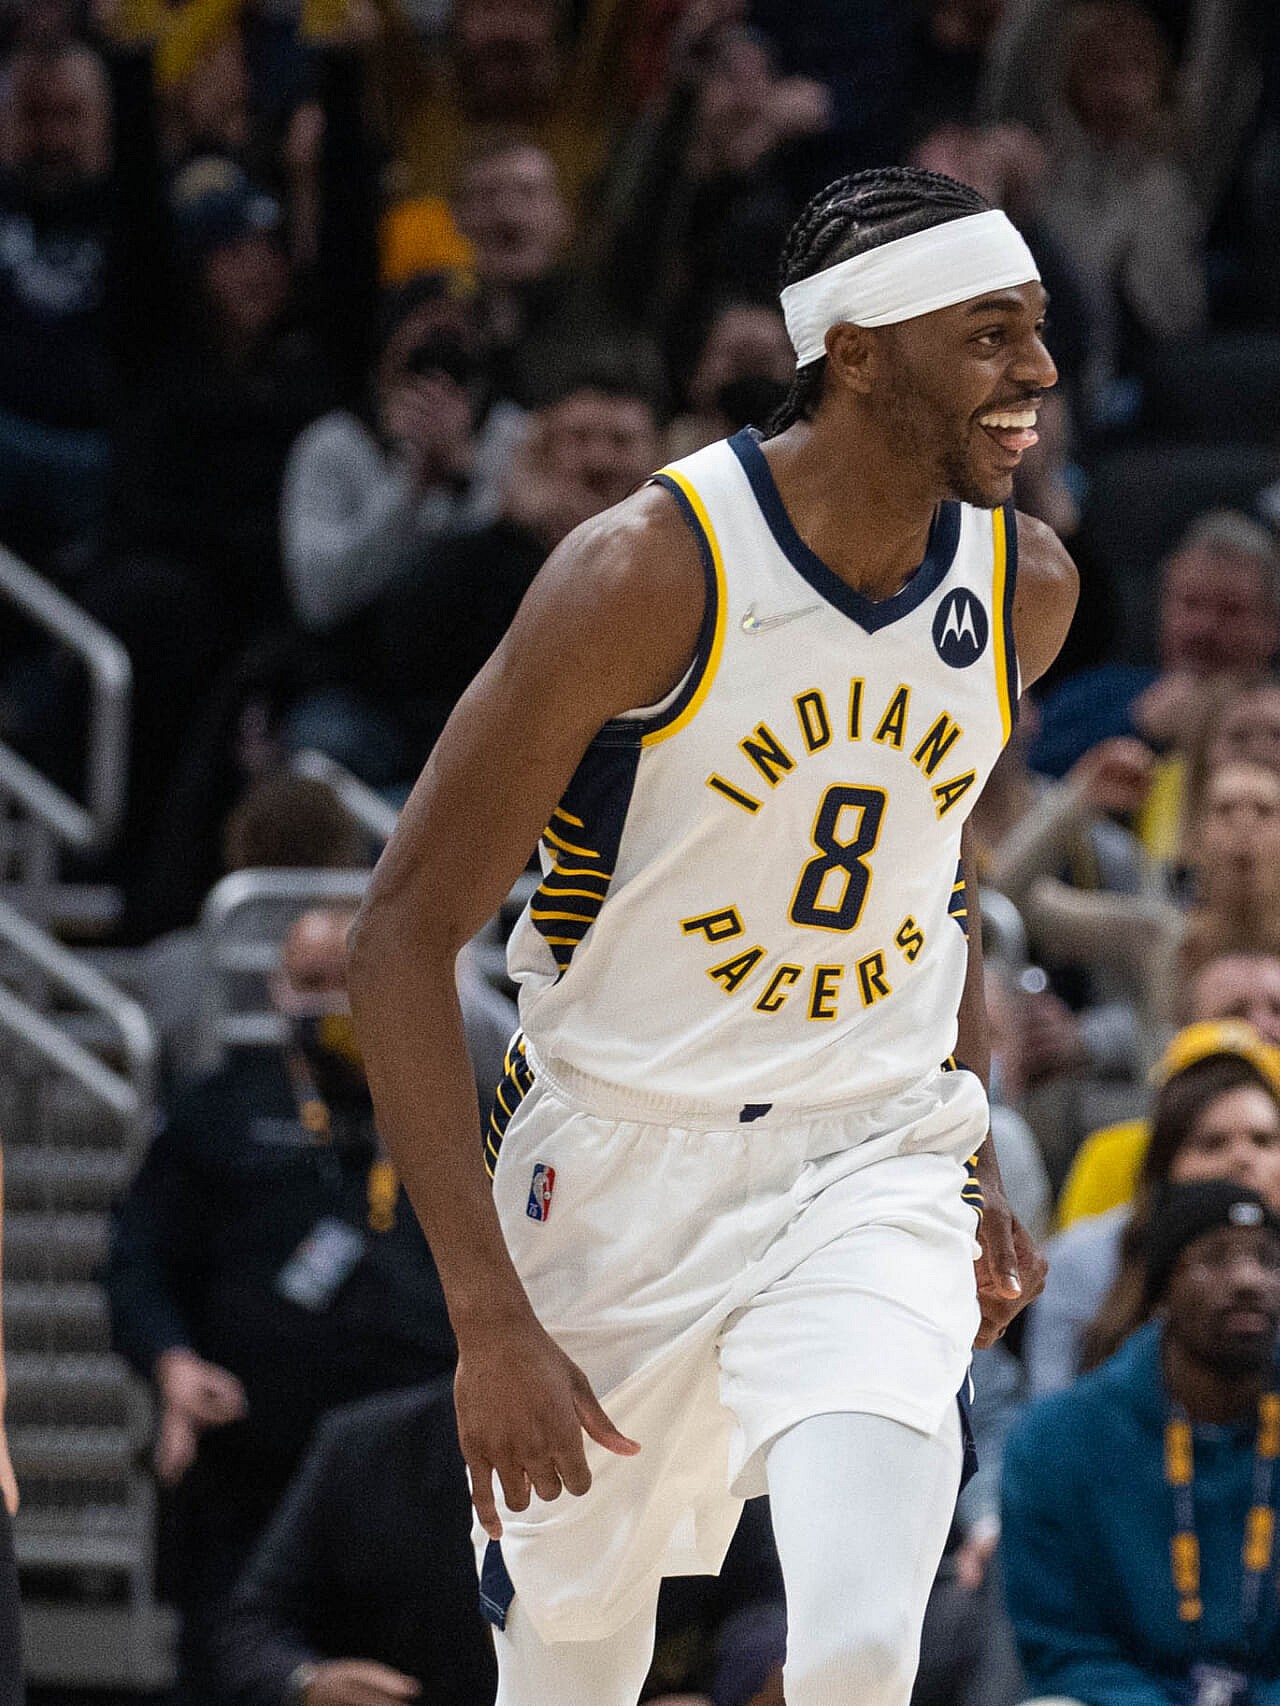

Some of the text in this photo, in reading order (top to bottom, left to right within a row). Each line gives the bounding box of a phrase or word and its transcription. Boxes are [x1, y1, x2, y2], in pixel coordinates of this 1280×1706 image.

[707, 678, 977, 819] INDIANA
[788, 782, 888, 932] 8
[680, 904, 924, 1021] PACERS
